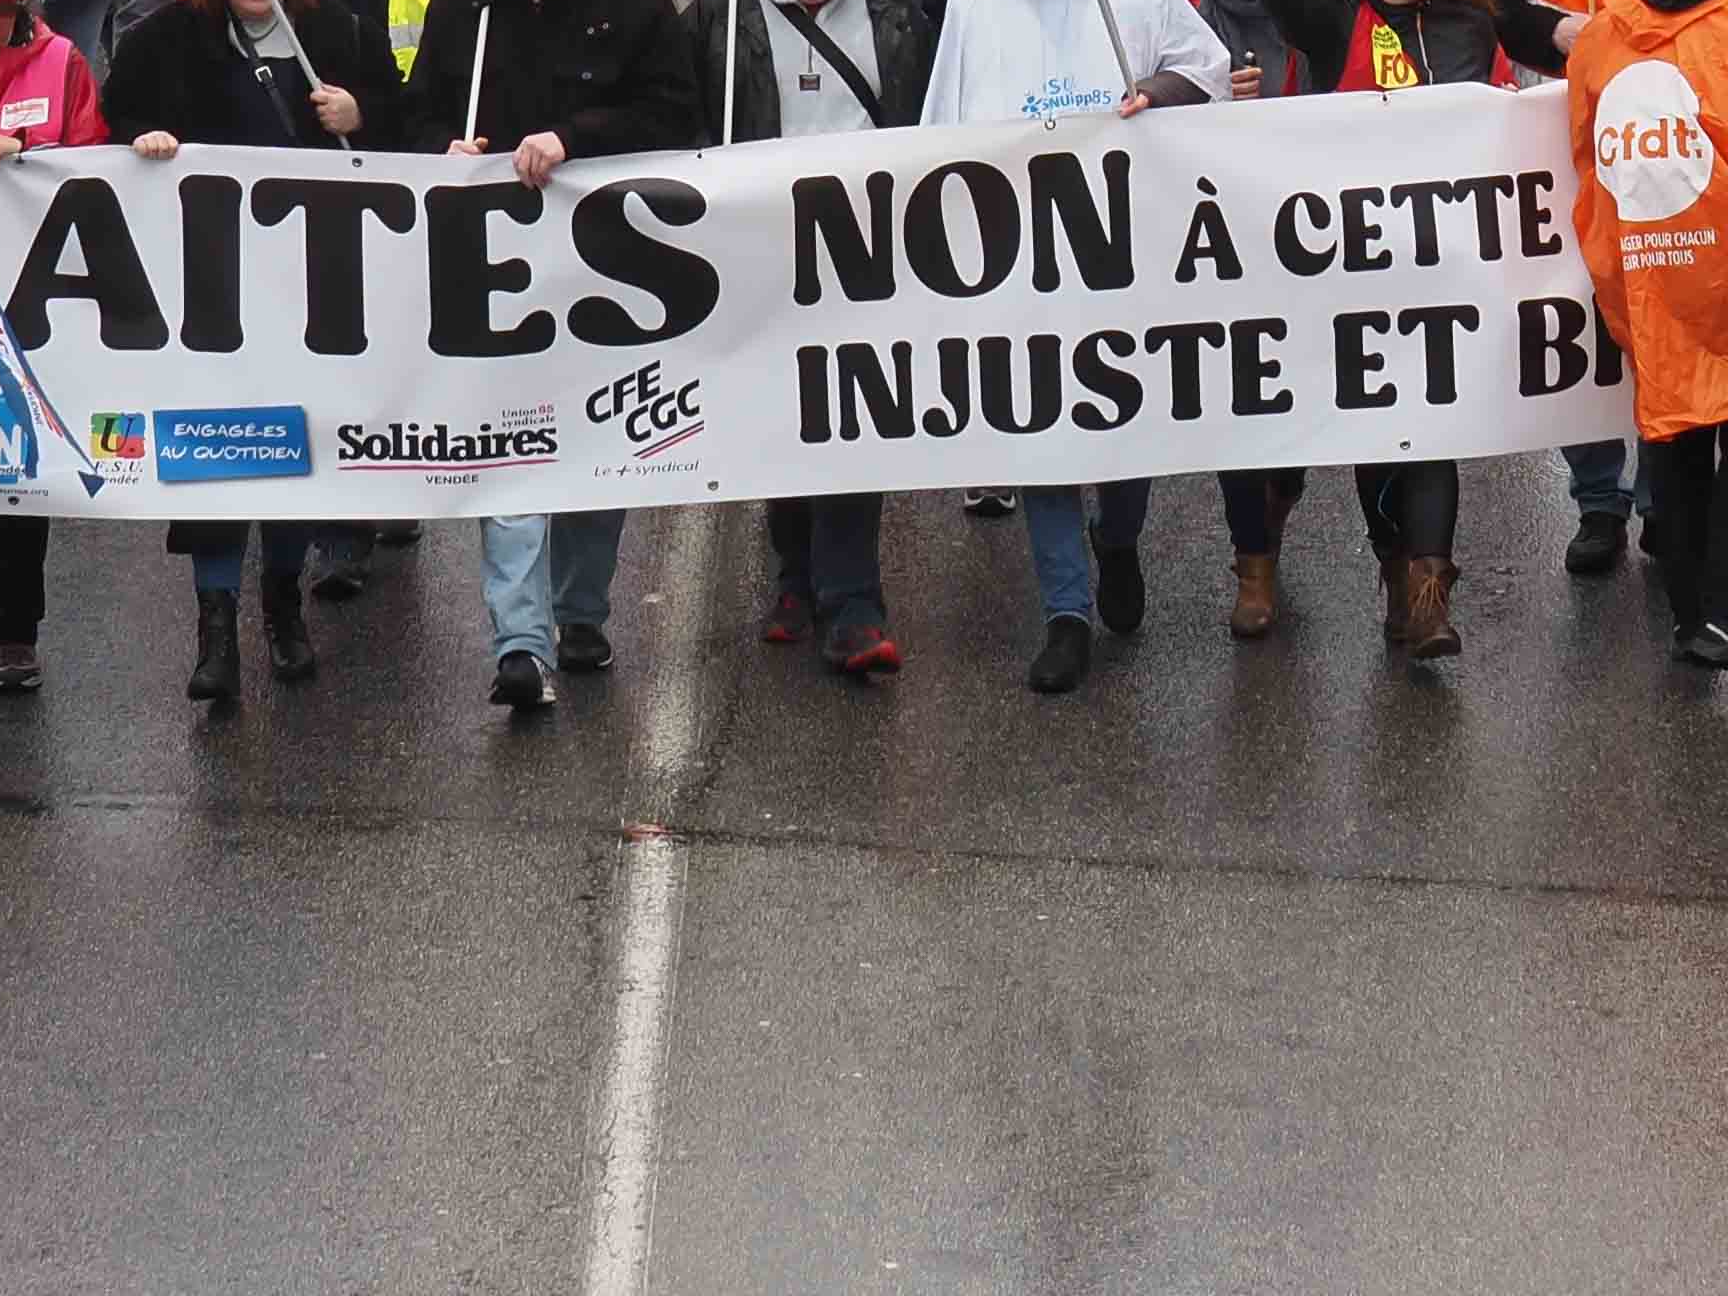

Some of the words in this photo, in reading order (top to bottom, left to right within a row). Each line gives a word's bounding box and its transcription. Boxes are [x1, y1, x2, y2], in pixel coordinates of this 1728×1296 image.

[1380, 53, 1409, 85] FO
[1598, 117, 1704, 168] Cfdt:
[790, 148, 1137, 307] NON
[1174, 175, 1244, 284] À
[1273, 169, 1564, 277] CETTE
[1644, 232, 1673, 249] POUR
[1674, 228, 1716, 247] CHACUN
[1666, 249, 1694, 266] TOUS
[584, 359, 662, 425] CFE
[795, 317, 1296, 445] INJUSTE
[1332, 304, 1481, 411] ET
[624, 378, 701, 444] CGC
[159, 443, 189, 463] AU
[193, 441, 302, 463] QUOTIDIEN
[336, 422, 558, 462] Solidaires
[424, 472, 479, 486] VENDÉE
[634, 459, 701, 477] syndical
